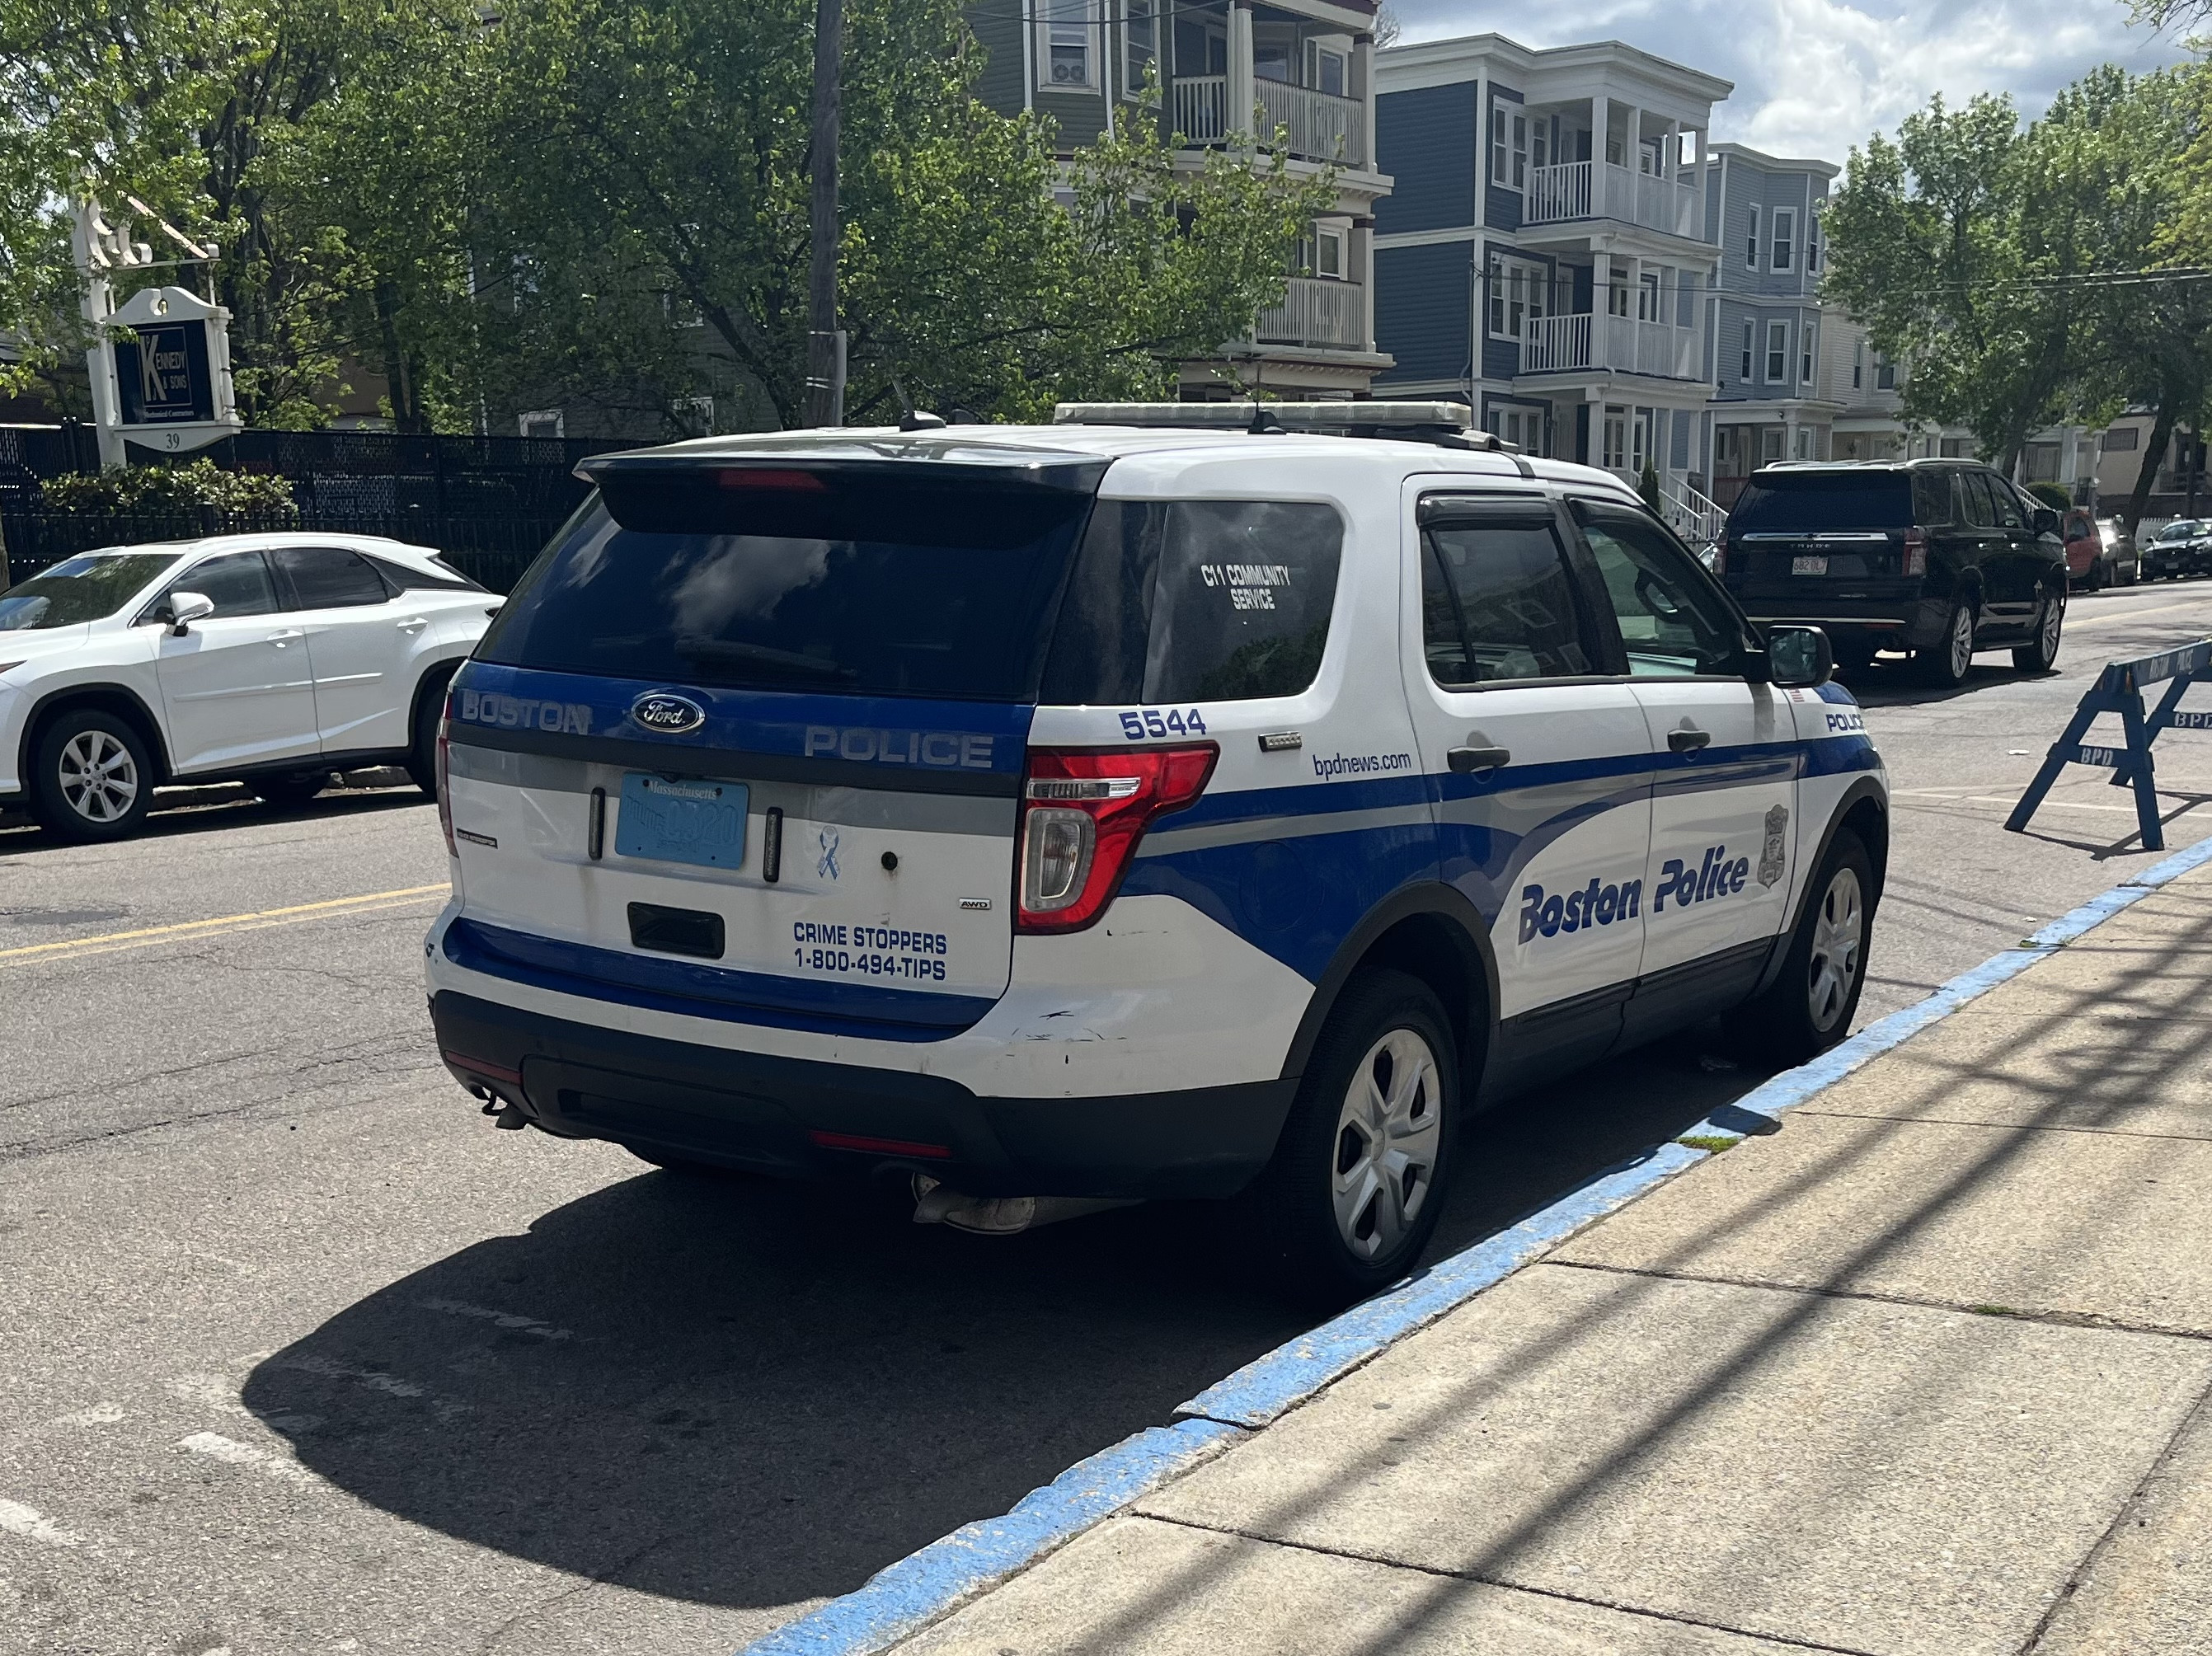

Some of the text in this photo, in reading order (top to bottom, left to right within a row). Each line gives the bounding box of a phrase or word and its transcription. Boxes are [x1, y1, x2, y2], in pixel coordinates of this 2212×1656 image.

[170, 375, 187, 389] SONS
[166, 433, 180, 449] 39
[1201, 565, 1290, 586] C11 COMMUNITY
[1231, 589, 1275, 610] SERVICE
[463, 690, 592, 734] BOSTON
[643, 701, 685, 725] Ford
[1118, 708, 1206, 740] 5544
[805, 725, 993, 768] POLICE
[2080, 747, 2114, 766] BPD
[1313, 753, 1411, 781] bpdnews.com
[648, 781, 717, 800] Massachusetts
[1519, 878, 1642, 945] Boston
[1654, 845, 1749, 913] Police
[794, 922, 946, 955] CRIME STOPPERS
[794, 948, 946, 981] 1-800-494-TIPS
